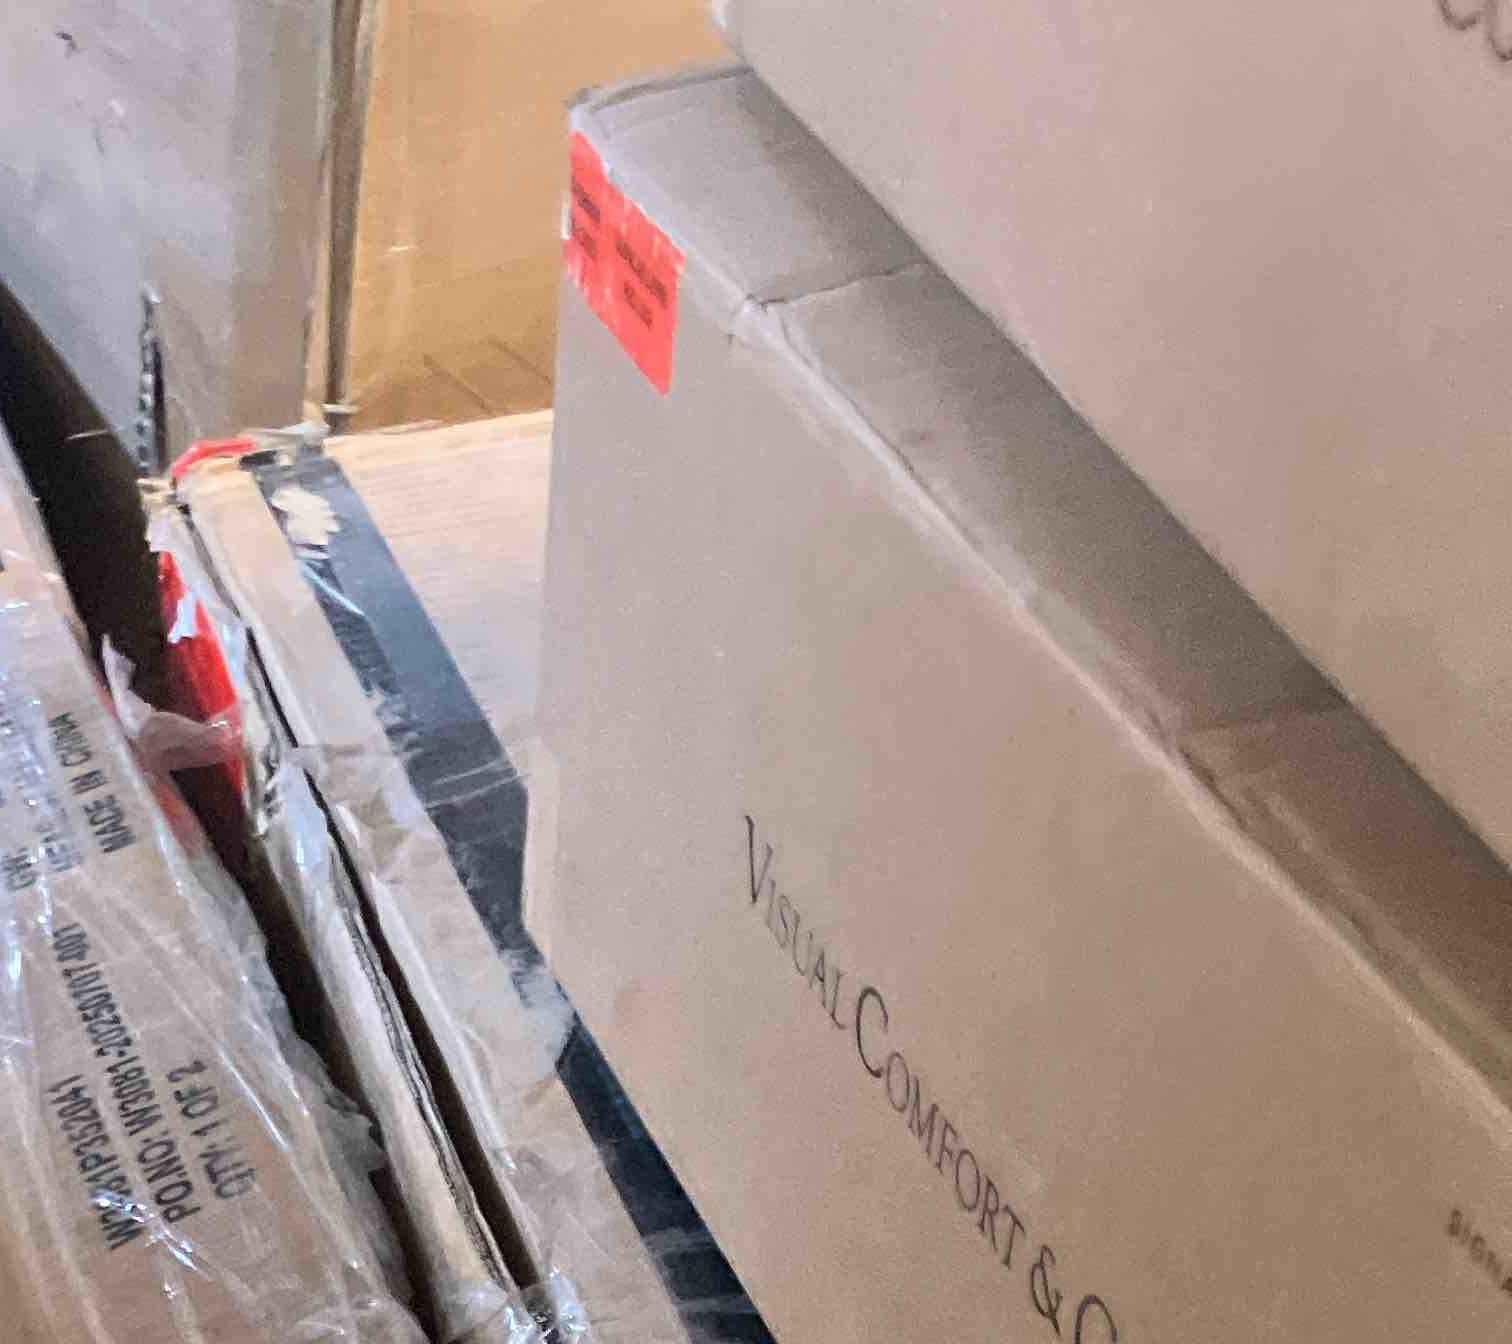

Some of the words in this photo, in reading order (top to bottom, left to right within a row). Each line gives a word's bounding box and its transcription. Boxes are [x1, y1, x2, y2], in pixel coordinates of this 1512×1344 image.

[49, 711, 92, 768] CHINA
[69, 770, 110, 796] IN
[82, 795, 136, 854] MADE
[165, 1059, 207, 1083] 2
[173, 1085, 219, 1119] OF
[190, 1118, 229, 1137] 1
[46, 1074, 145, 1251] W81P352041
[1030, 1244, 1063, 1337] &
